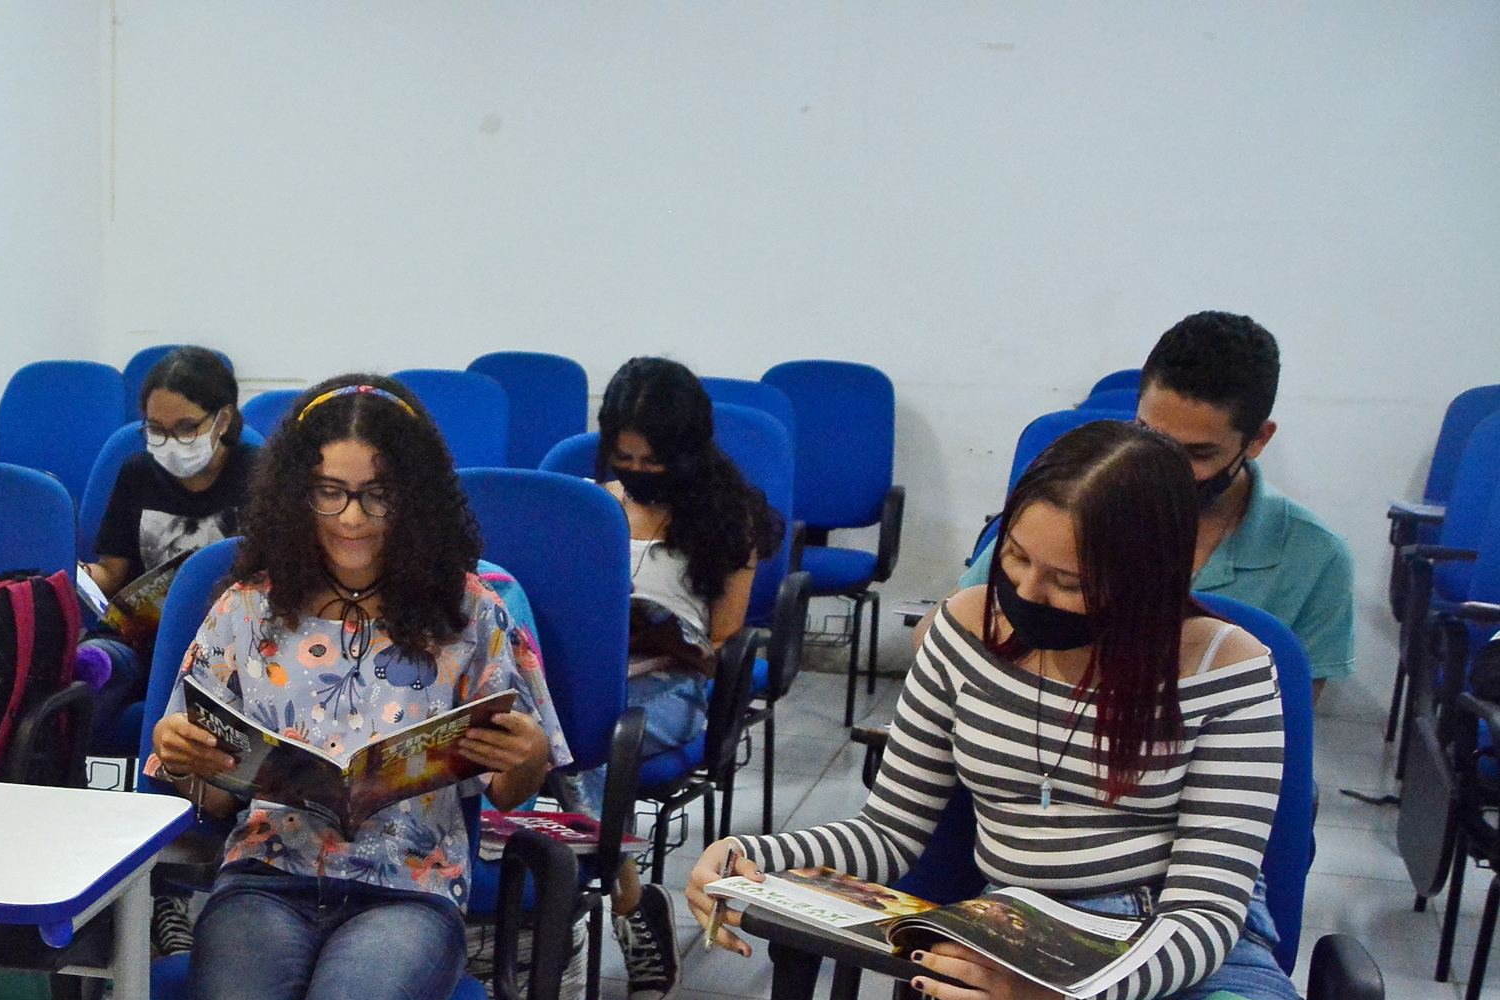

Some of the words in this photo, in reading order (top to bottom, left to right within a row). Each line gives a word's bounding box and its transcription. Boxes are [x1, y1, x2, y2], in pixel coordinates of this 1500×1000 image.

[194, 702, 250, 741] TIME
[197, 718, 252, 752] ZONES
[380, 714, 472, 757] TIME
